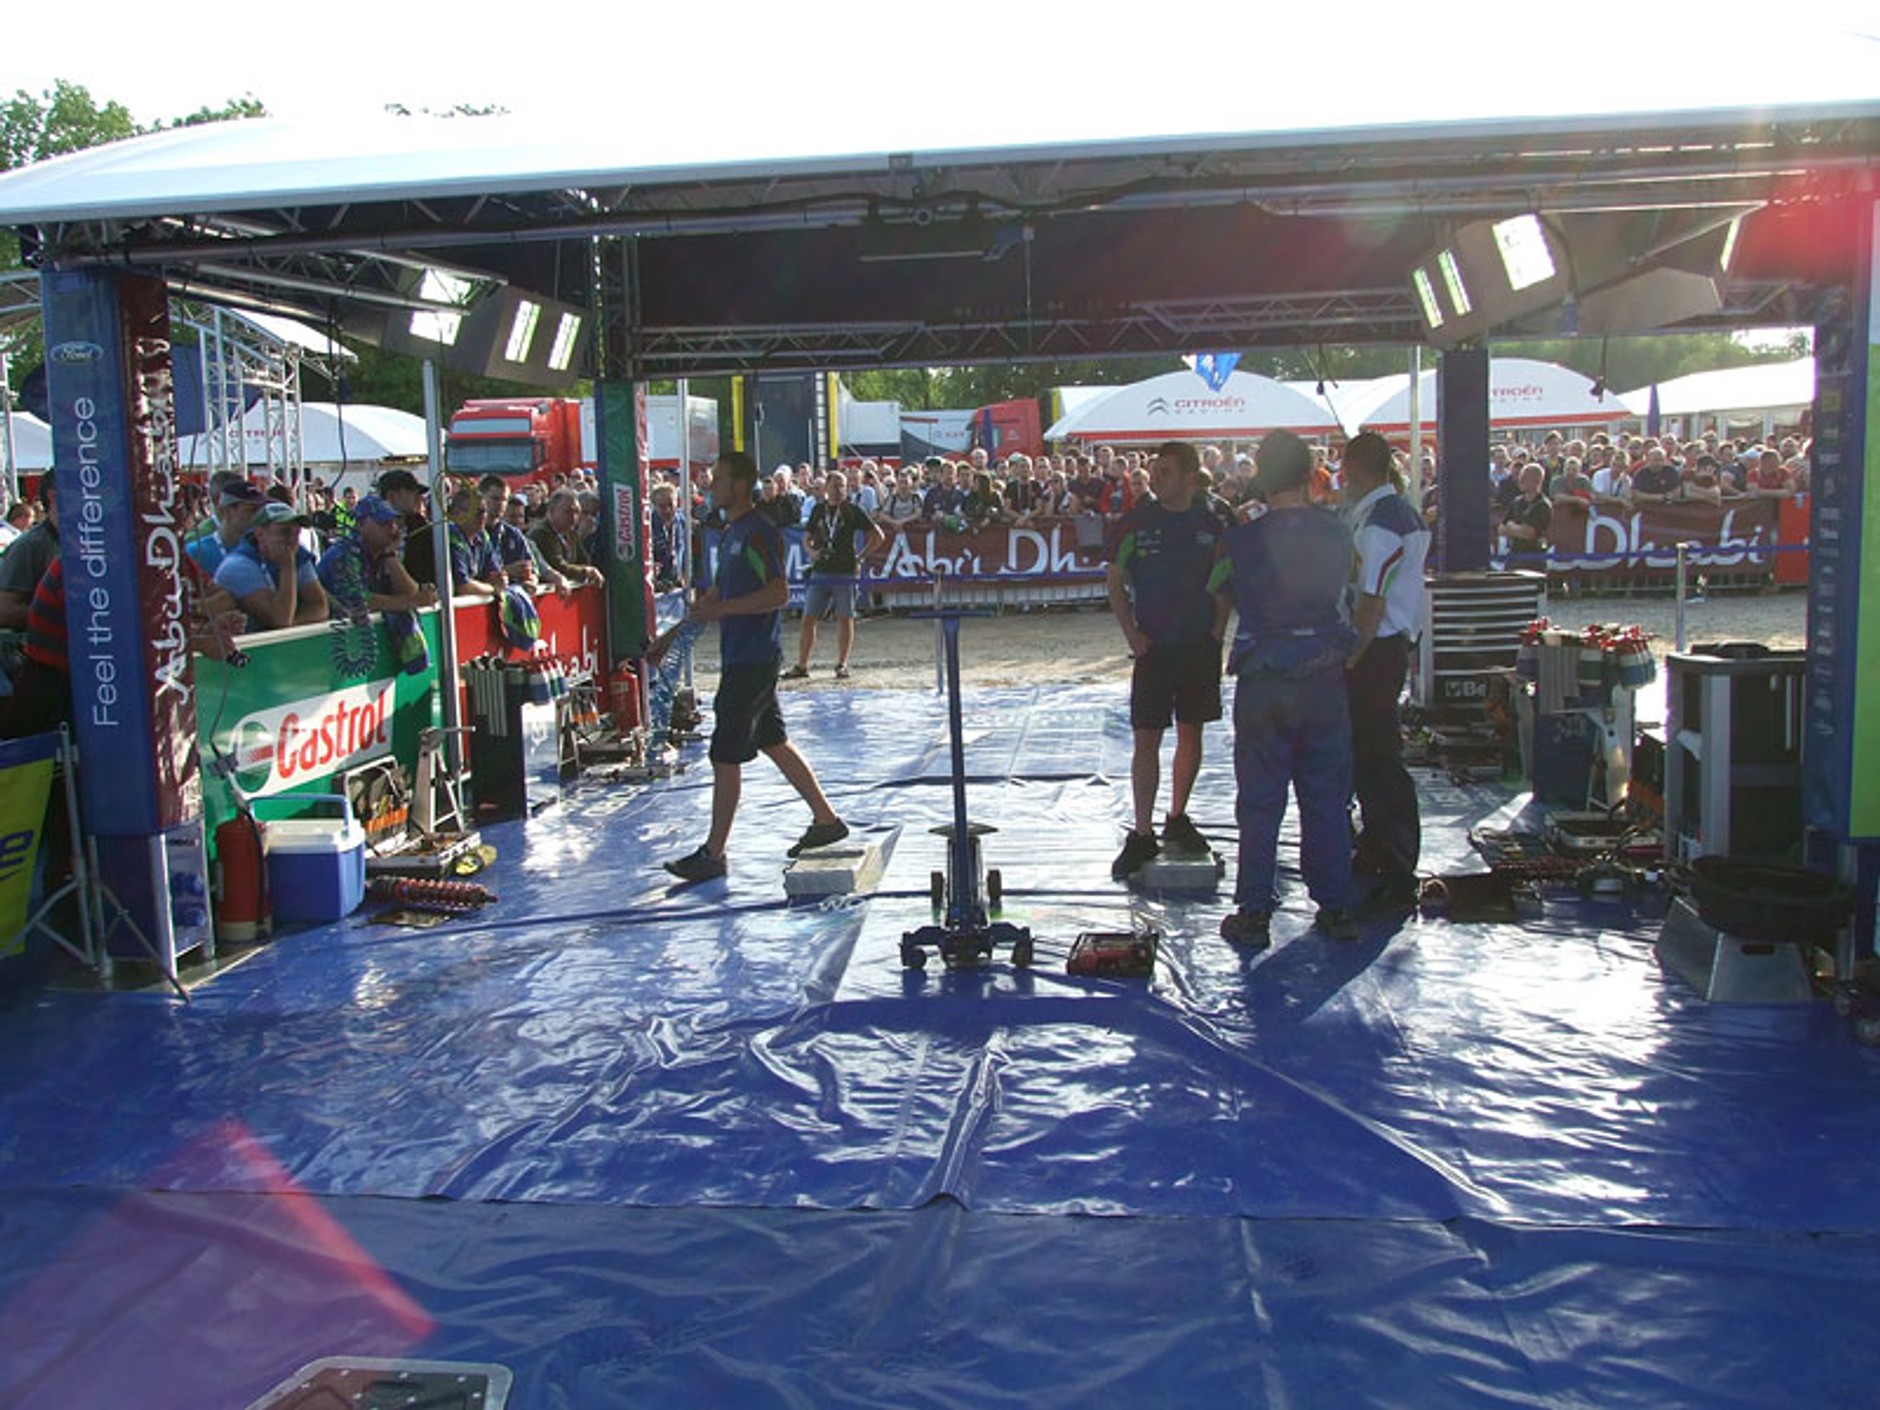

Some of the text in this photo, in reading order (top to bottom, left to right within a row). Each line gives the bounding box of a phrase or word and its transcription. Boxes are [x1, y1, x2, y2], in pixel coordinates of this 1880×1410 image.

[75, 396, 118, 725] Feel the difference
[617, 488, 632, 544] Castrol
[152, 588, 189, 704] Abu
[276, 689, 387, 779] Castrol
